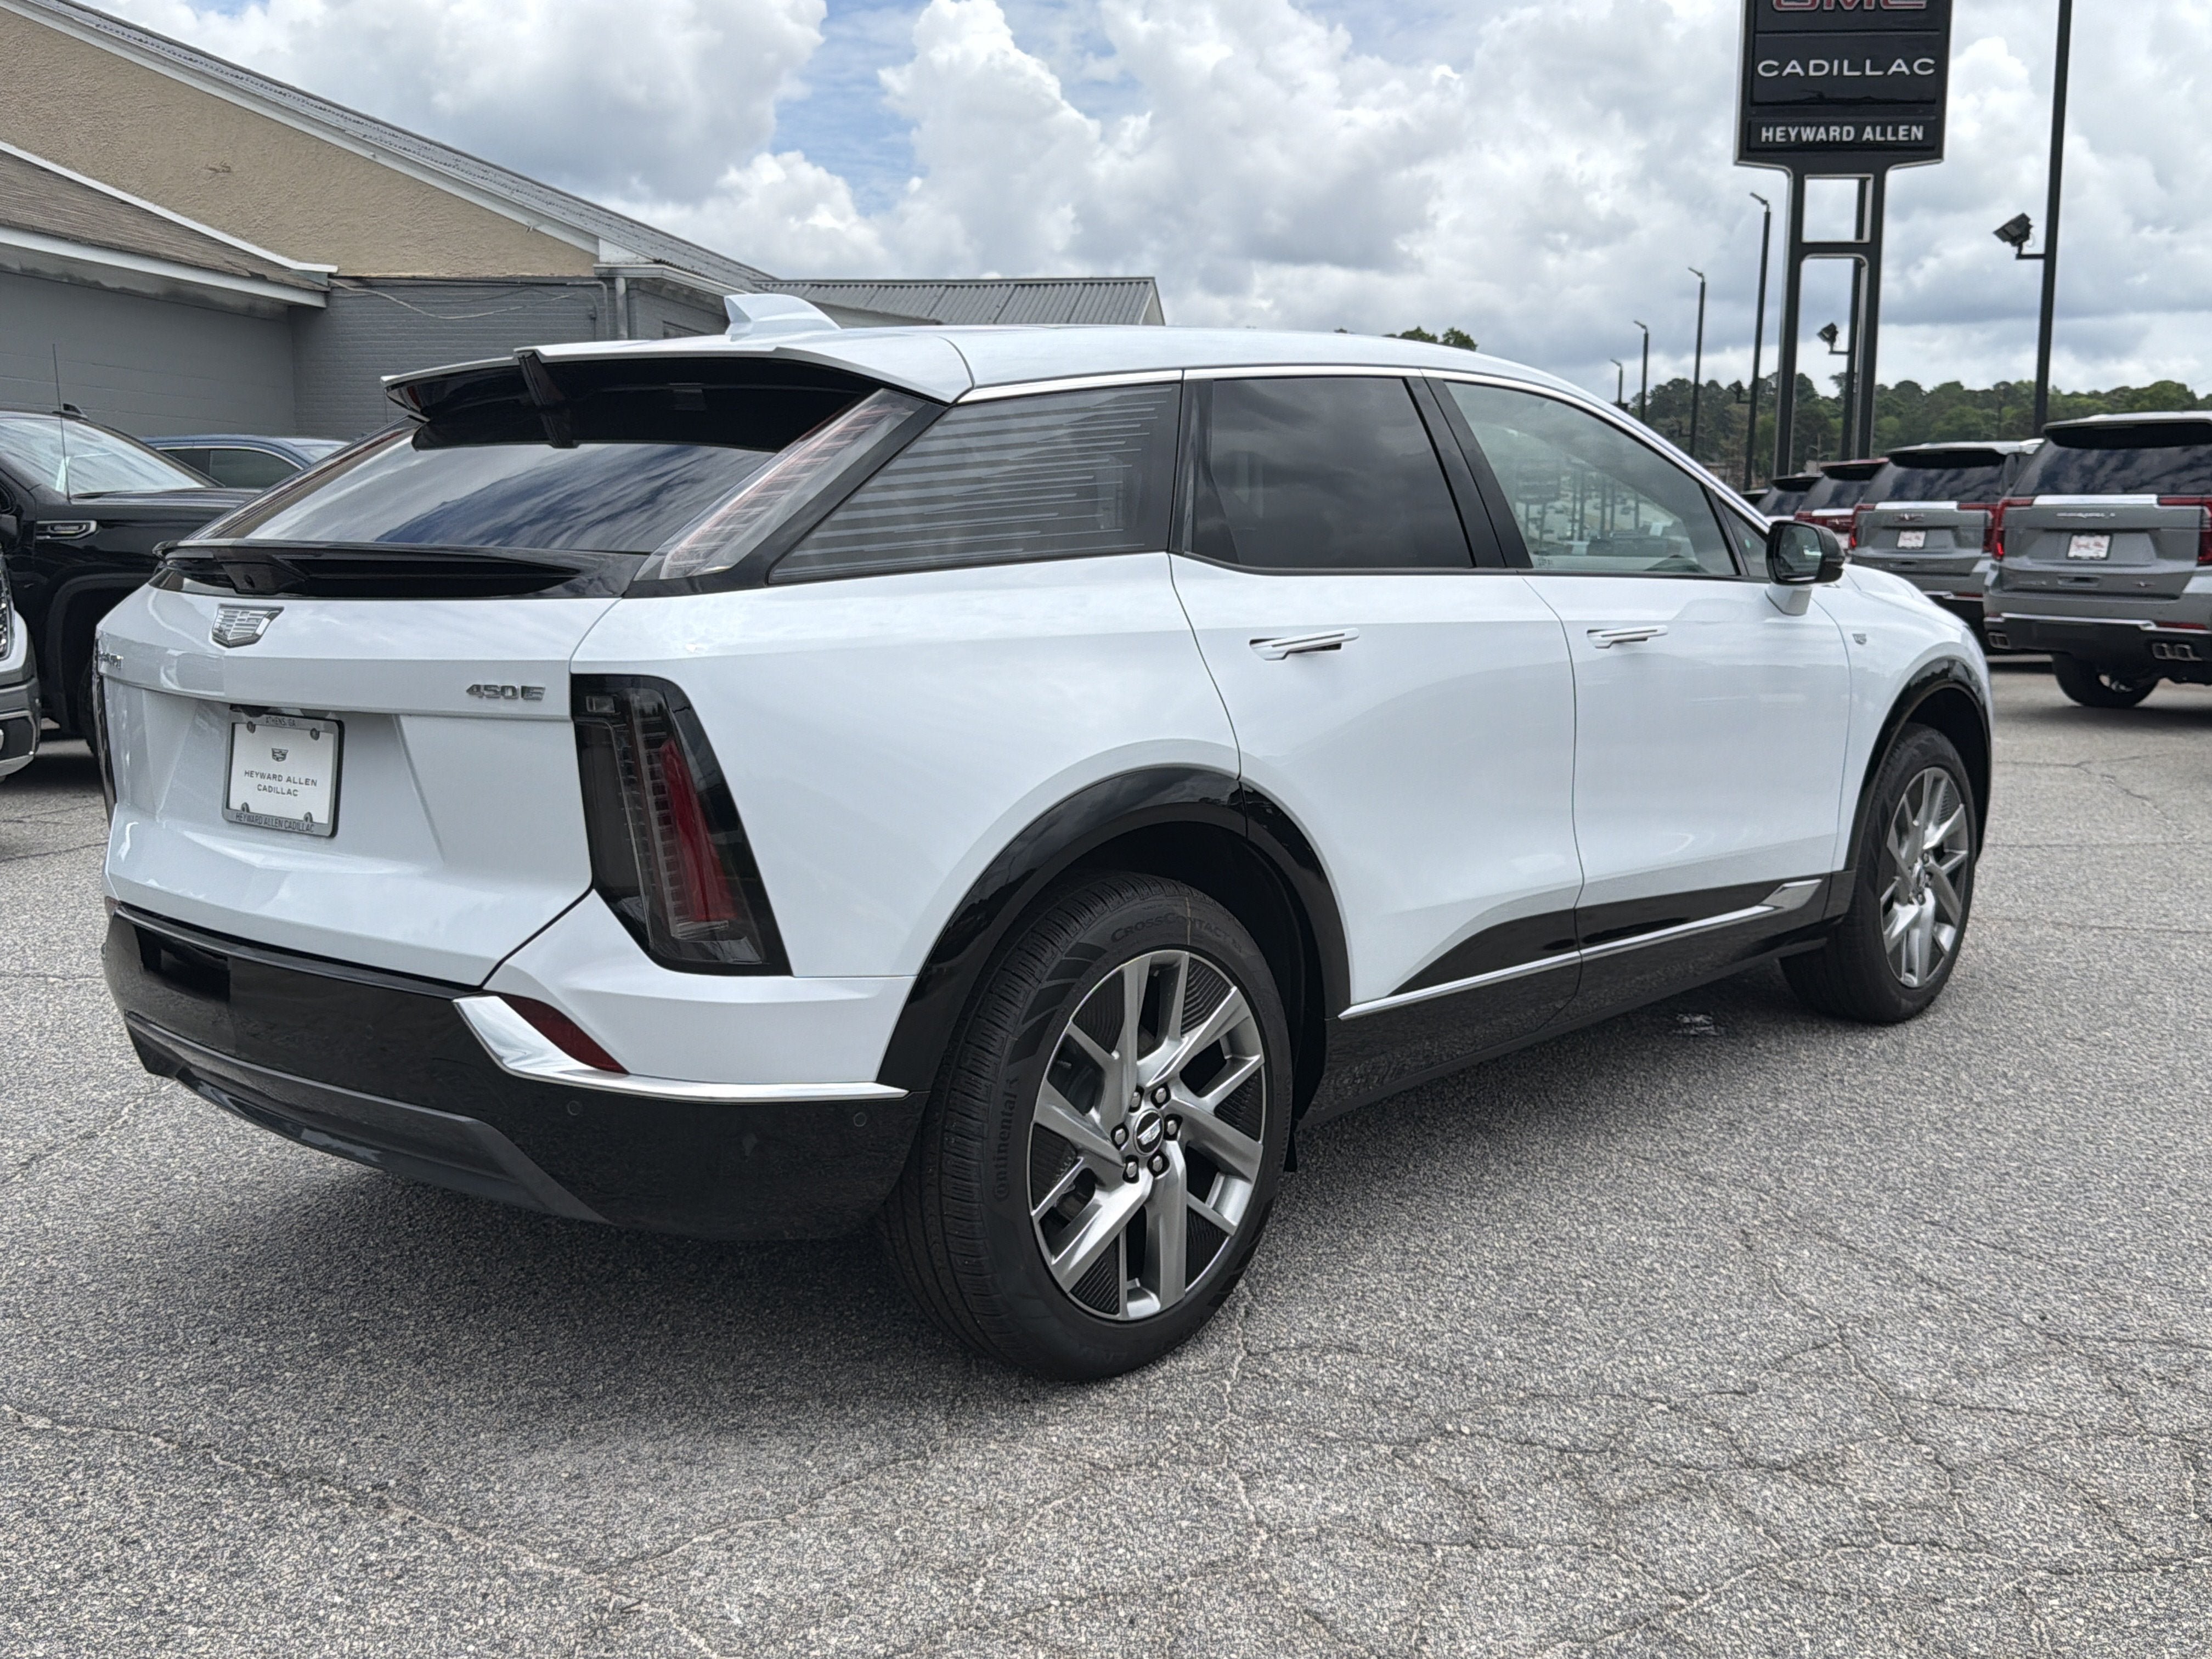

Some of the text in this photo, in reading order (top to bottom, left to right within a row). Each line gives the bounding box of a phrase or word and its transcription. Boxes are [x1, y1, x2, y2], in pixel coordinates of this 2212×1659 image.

[1757, 58, 1936, 77] CADILLAC
[1761, 125, 1924, 143] HEYWARD ALLEN
[244, 770, 318, 787] HEYWARD ALLEN
[257, 783, 299, 797] CADILLAC
[235, 812, 314, 833] HEYWARD ALLEN CADILLAC
[994, 1091, 1017, 1203] Continental
